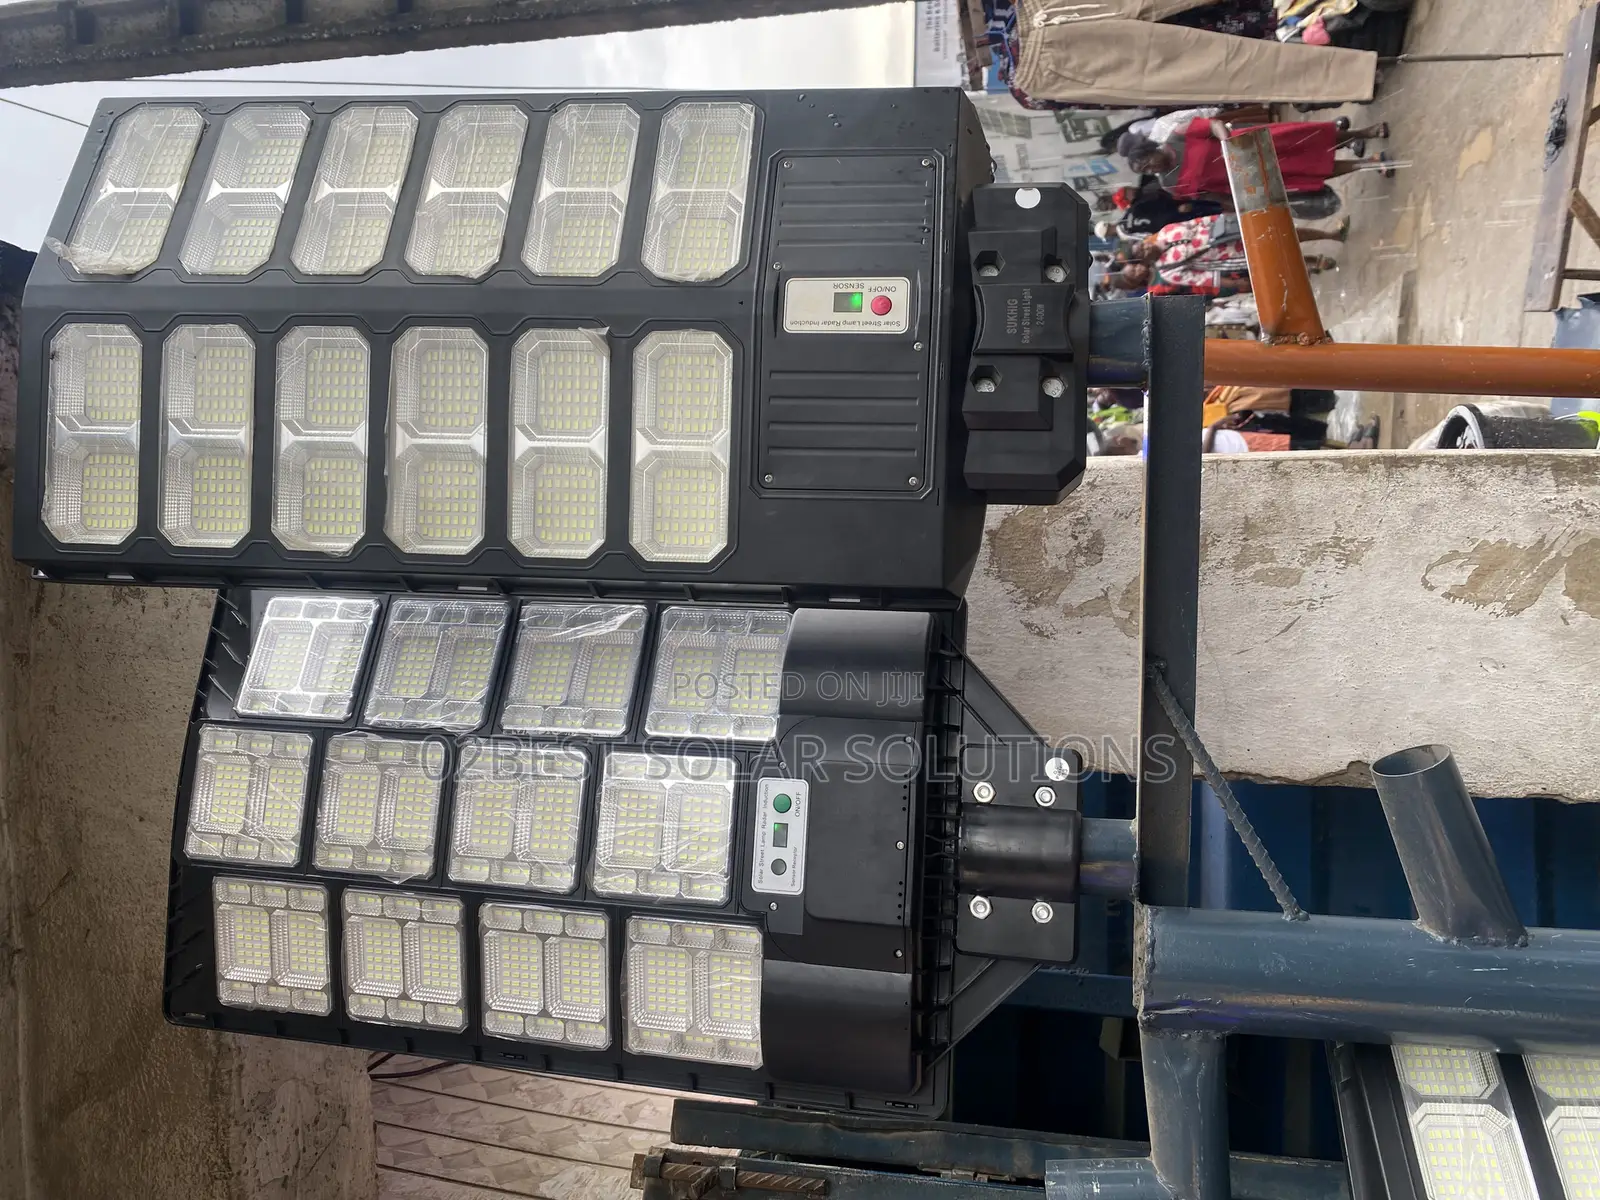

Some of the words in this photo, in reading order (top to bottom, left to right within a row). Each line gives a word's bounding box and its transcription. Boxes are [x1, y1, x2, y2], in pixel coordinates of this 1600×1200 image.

[832, 282, 864, 290] SENSOR
[1022, 288, 1032, 306] Light
[1006, 298, 1018, 334] SUKHIG
[1022, 306, 1030, 326] Street
[1036, 304, 1044, 327] 2400W
[1021, 326, 1030, 344] Solar
